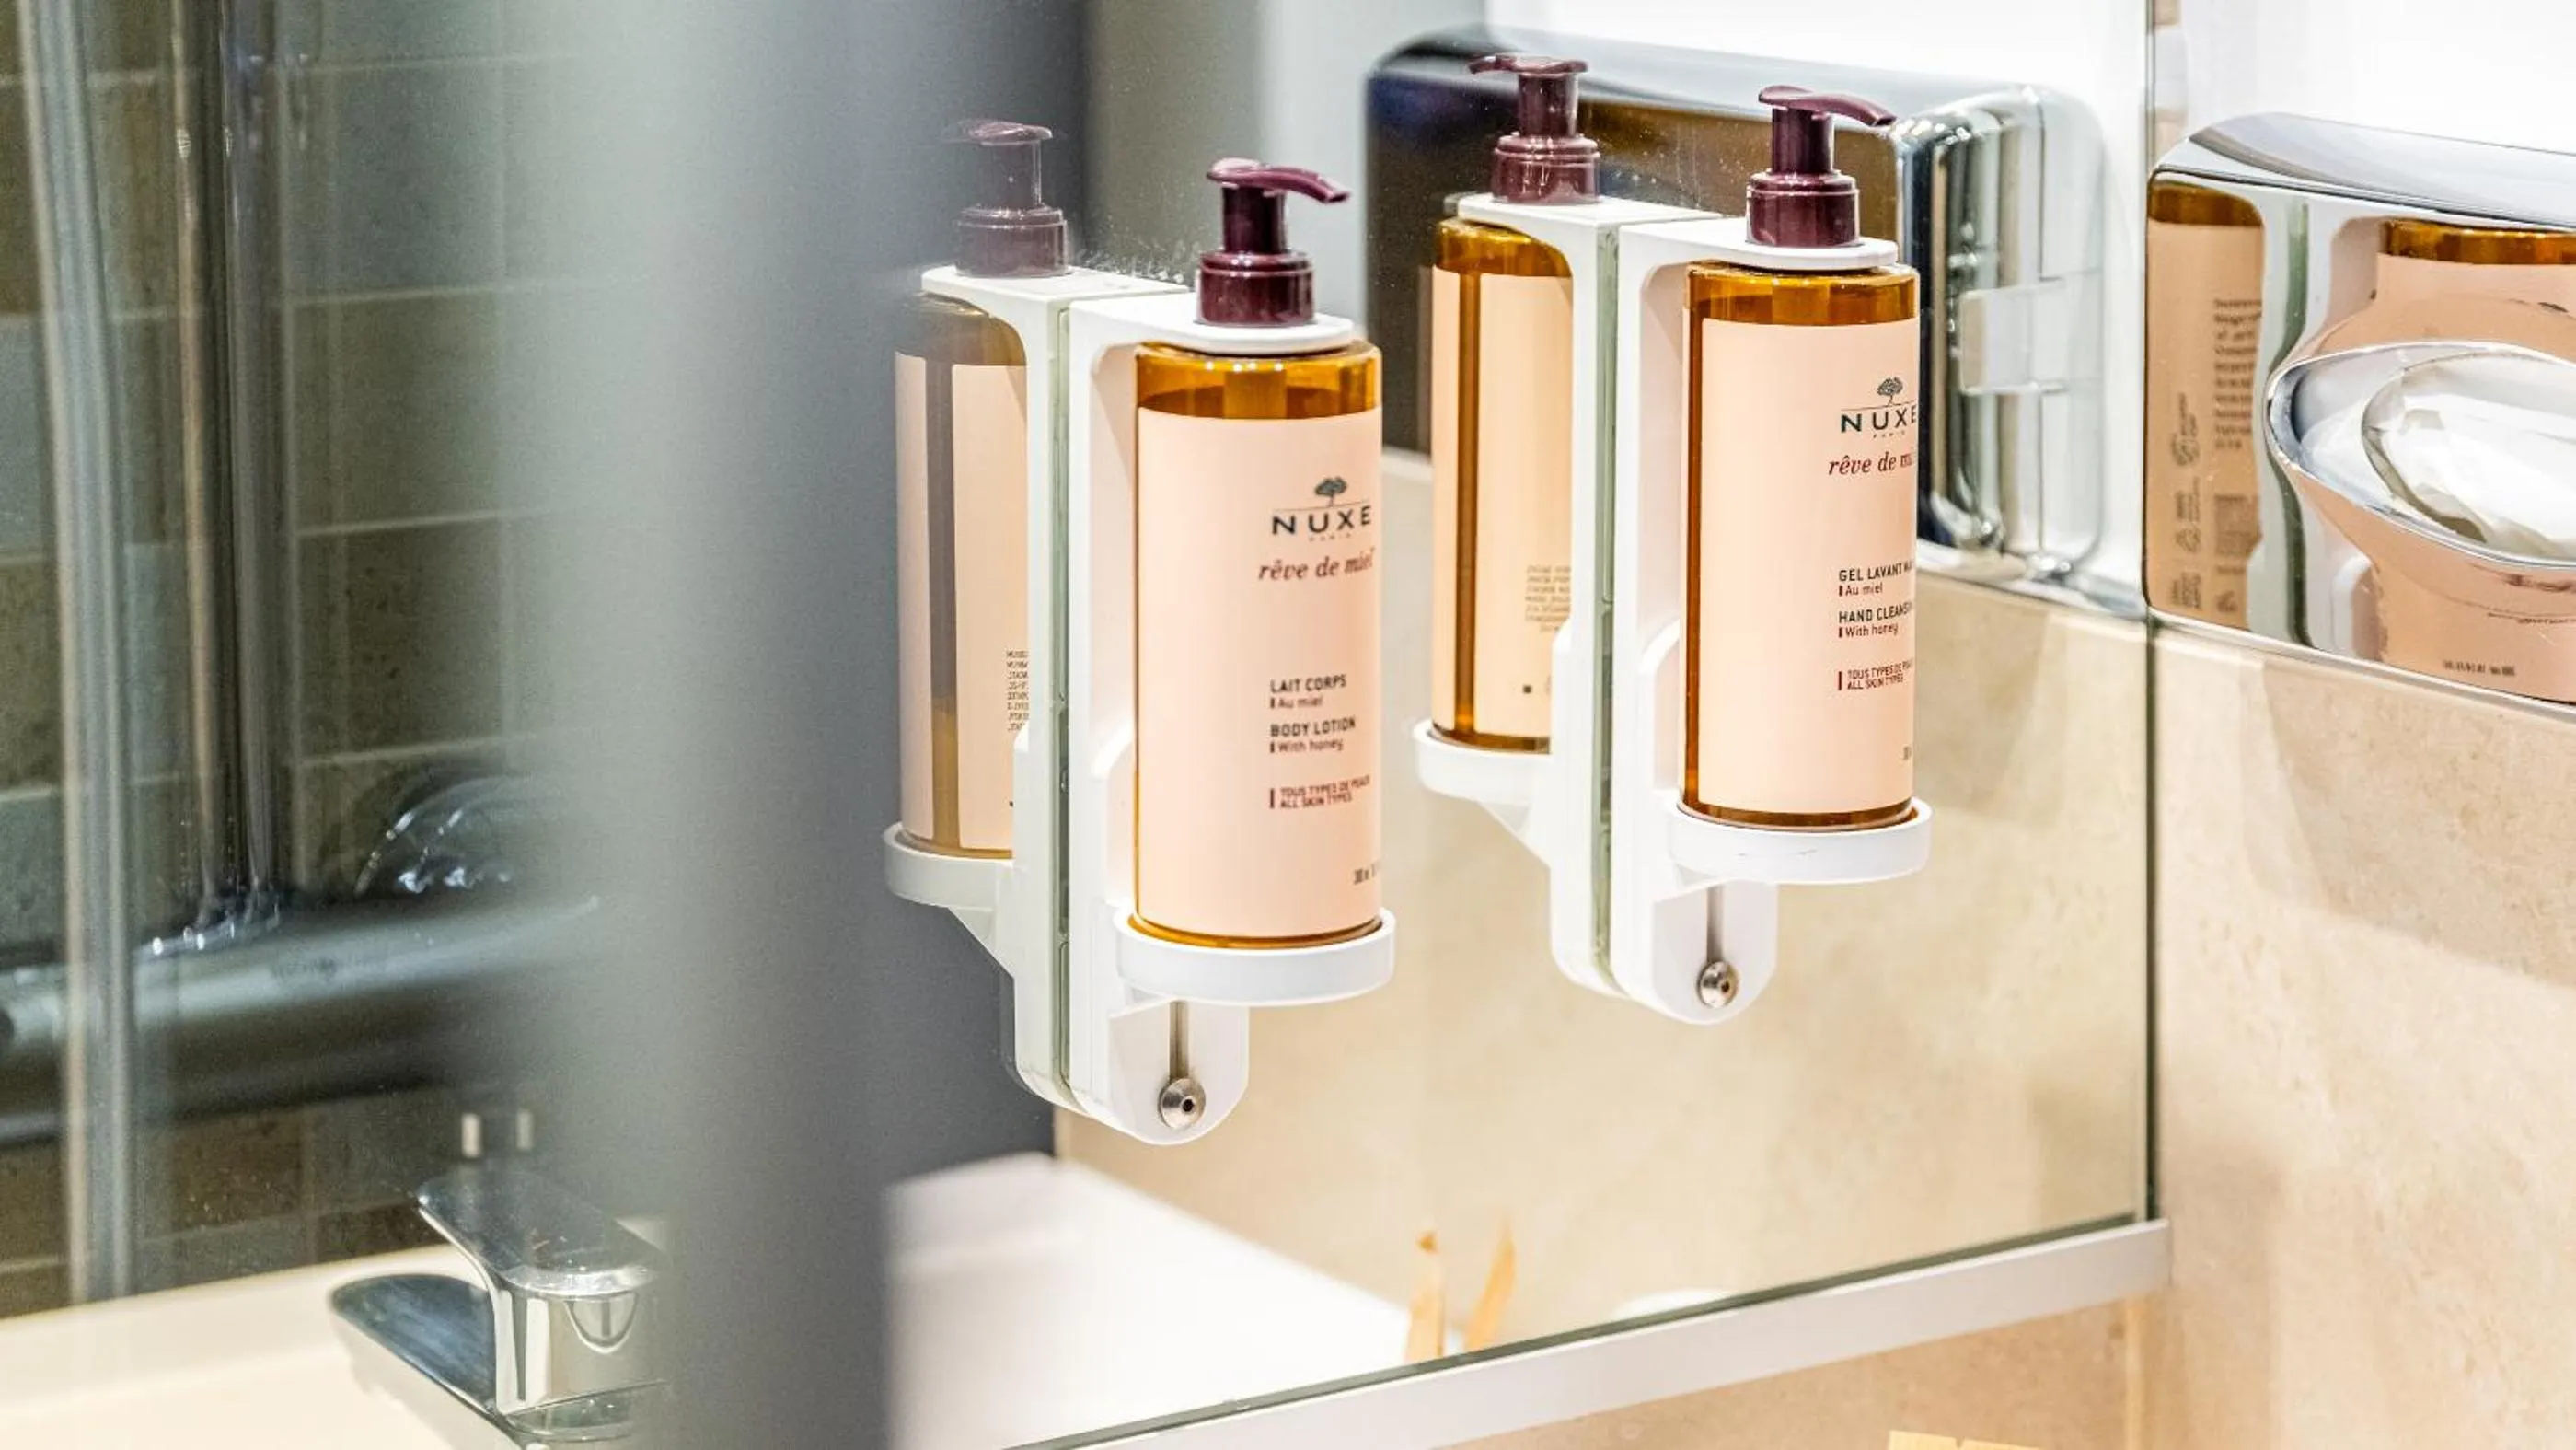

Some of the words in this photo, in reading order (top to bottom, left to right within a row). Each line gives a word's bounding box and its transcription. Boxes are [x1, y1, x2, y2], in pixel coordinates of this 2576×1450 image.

[1839, 404, 1916, 434] NUXE
[1828, 455, 1872, 475] rêve
[1877, 451, 1897, 472] de
[1272, 505, 1371, 536] NUXE
[1258, 558, 1309, 580] rêve
[1315, 555, 1339, 578] de
[1839, 567, 1864, 582] GEL
[1867, 563, 1902, 580] LAVANT
[1845, 585, 1859, 596] Au
[1862, 581, 1883, 595] miel
[1839, 609, 1873, 623] HAND
[1845, 625, 1869, 638] With
[1872, 622, 1899, 637] honey
[1847, 669, 1870, 679] TOUS
[1871, 665, 1893, 678] TYPES
[1270, 679, 1301, 693] LAIT
[1306, 674, 1346, 691] CORPS
[1847, 680, 1864, 690] ALL
[1865, 678, 1884, 690] SKIN
[1278, 697, 1294, 708] Au
[1270, 723, 1309, 737] BODY
[1313, 715, 1357, 736] LOTION
[1278, 740, 1307, 752] With
[1309, 738, 1345, 751] honey
[1280, 786, 1306, 797] TOUS
[1280, 798, 1299, 809] ALL
[1302, 797, 1325, 809] SKIN
